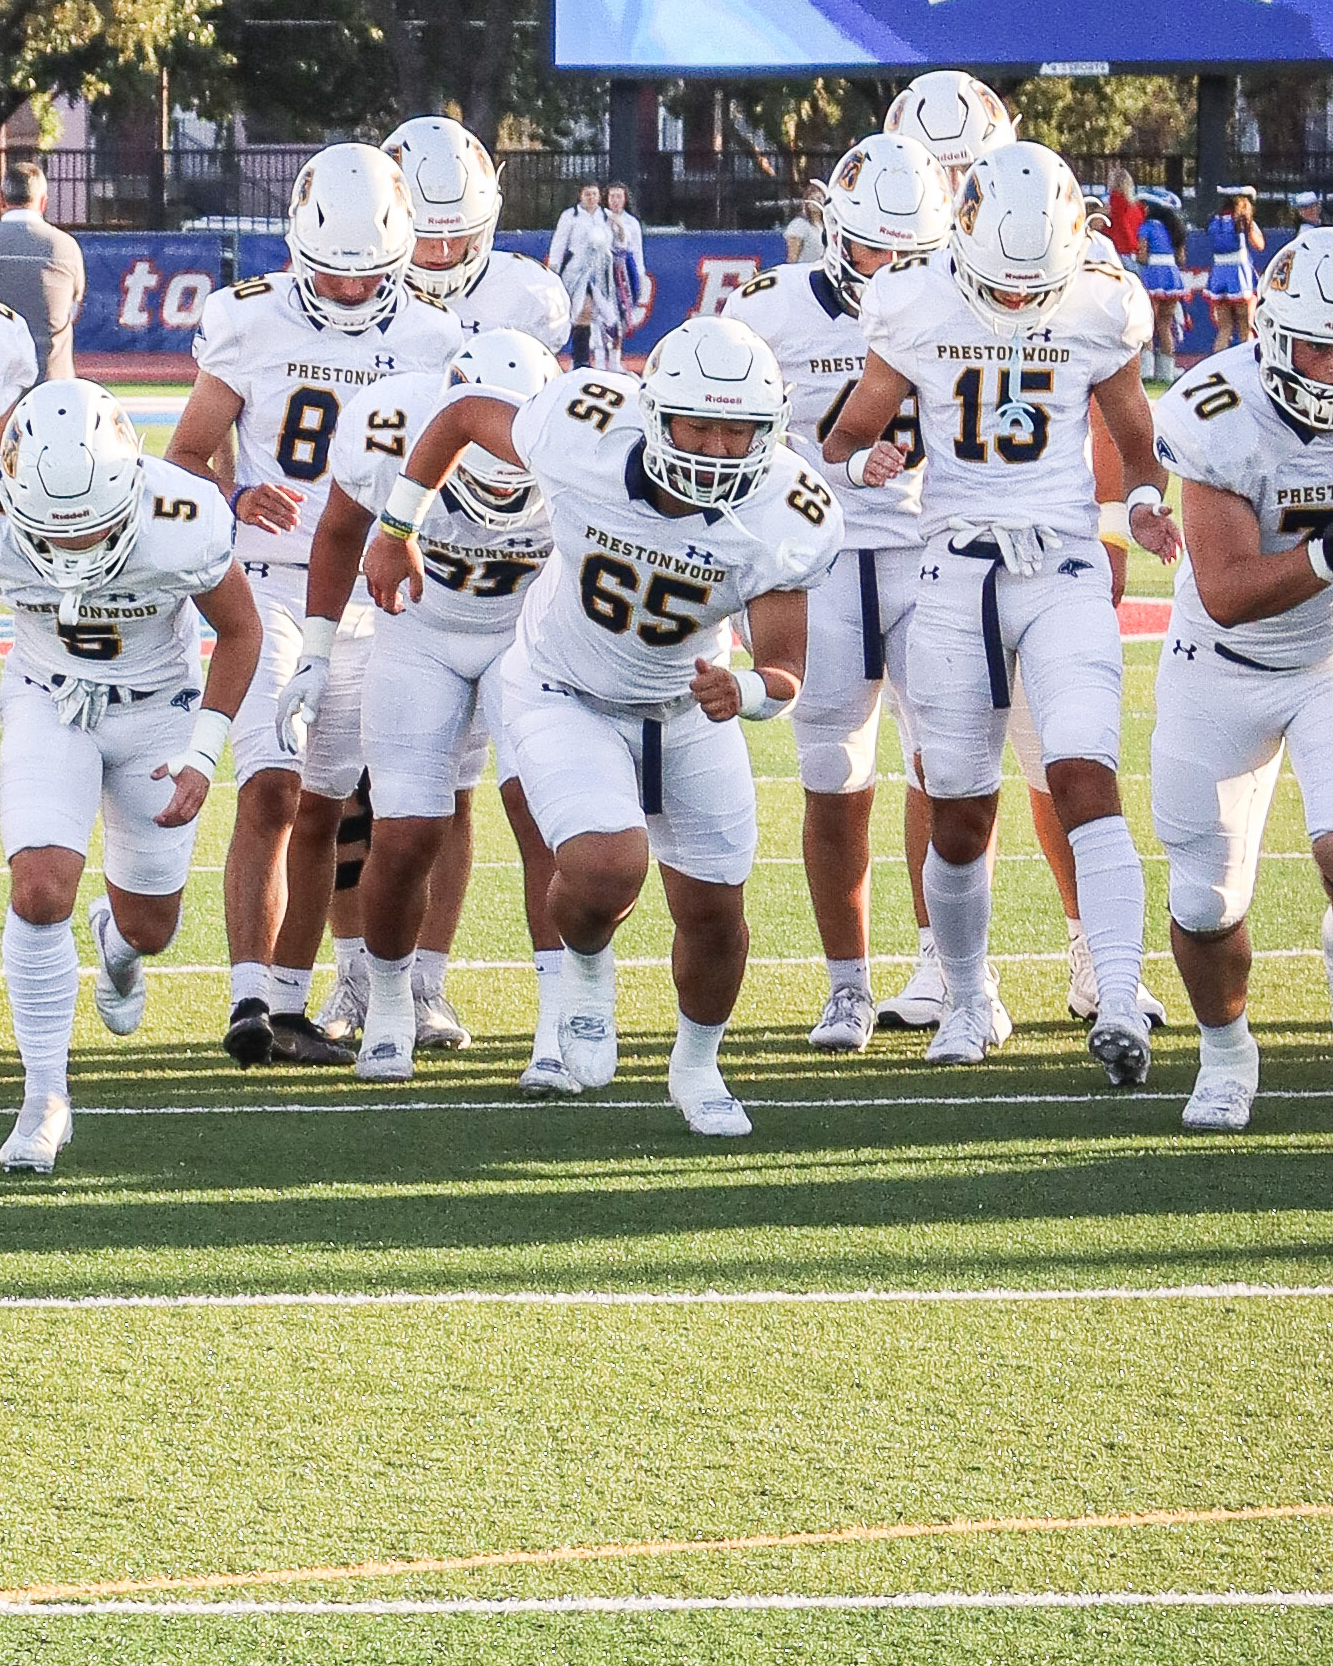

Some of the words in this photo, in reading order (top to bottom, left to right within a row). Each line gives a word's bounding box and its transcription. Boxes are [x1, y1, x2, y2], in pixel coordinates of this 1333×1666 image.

[879, 226, 914, 240] Riddell
[117, 257, 216, 331] to
[565, 382, 627, 434] 65
[705, 393, 743, 404] Riddell
[953, 366, 1055, 465] 15
[1182, 371, 1242, 420] 70
[275, 383, 342, 483] 8
[365, 408, 407, 459] 37
[51, 509, 90, 521] Riddell
[153, 496, 199, 522] 5
[785, 469, 833, 528] 65
[584, 524, 726, 583] PRESTONWOOD
[16, 599, 159, 620] PRESONWOOD
[579, 550, 713, 648] 65
